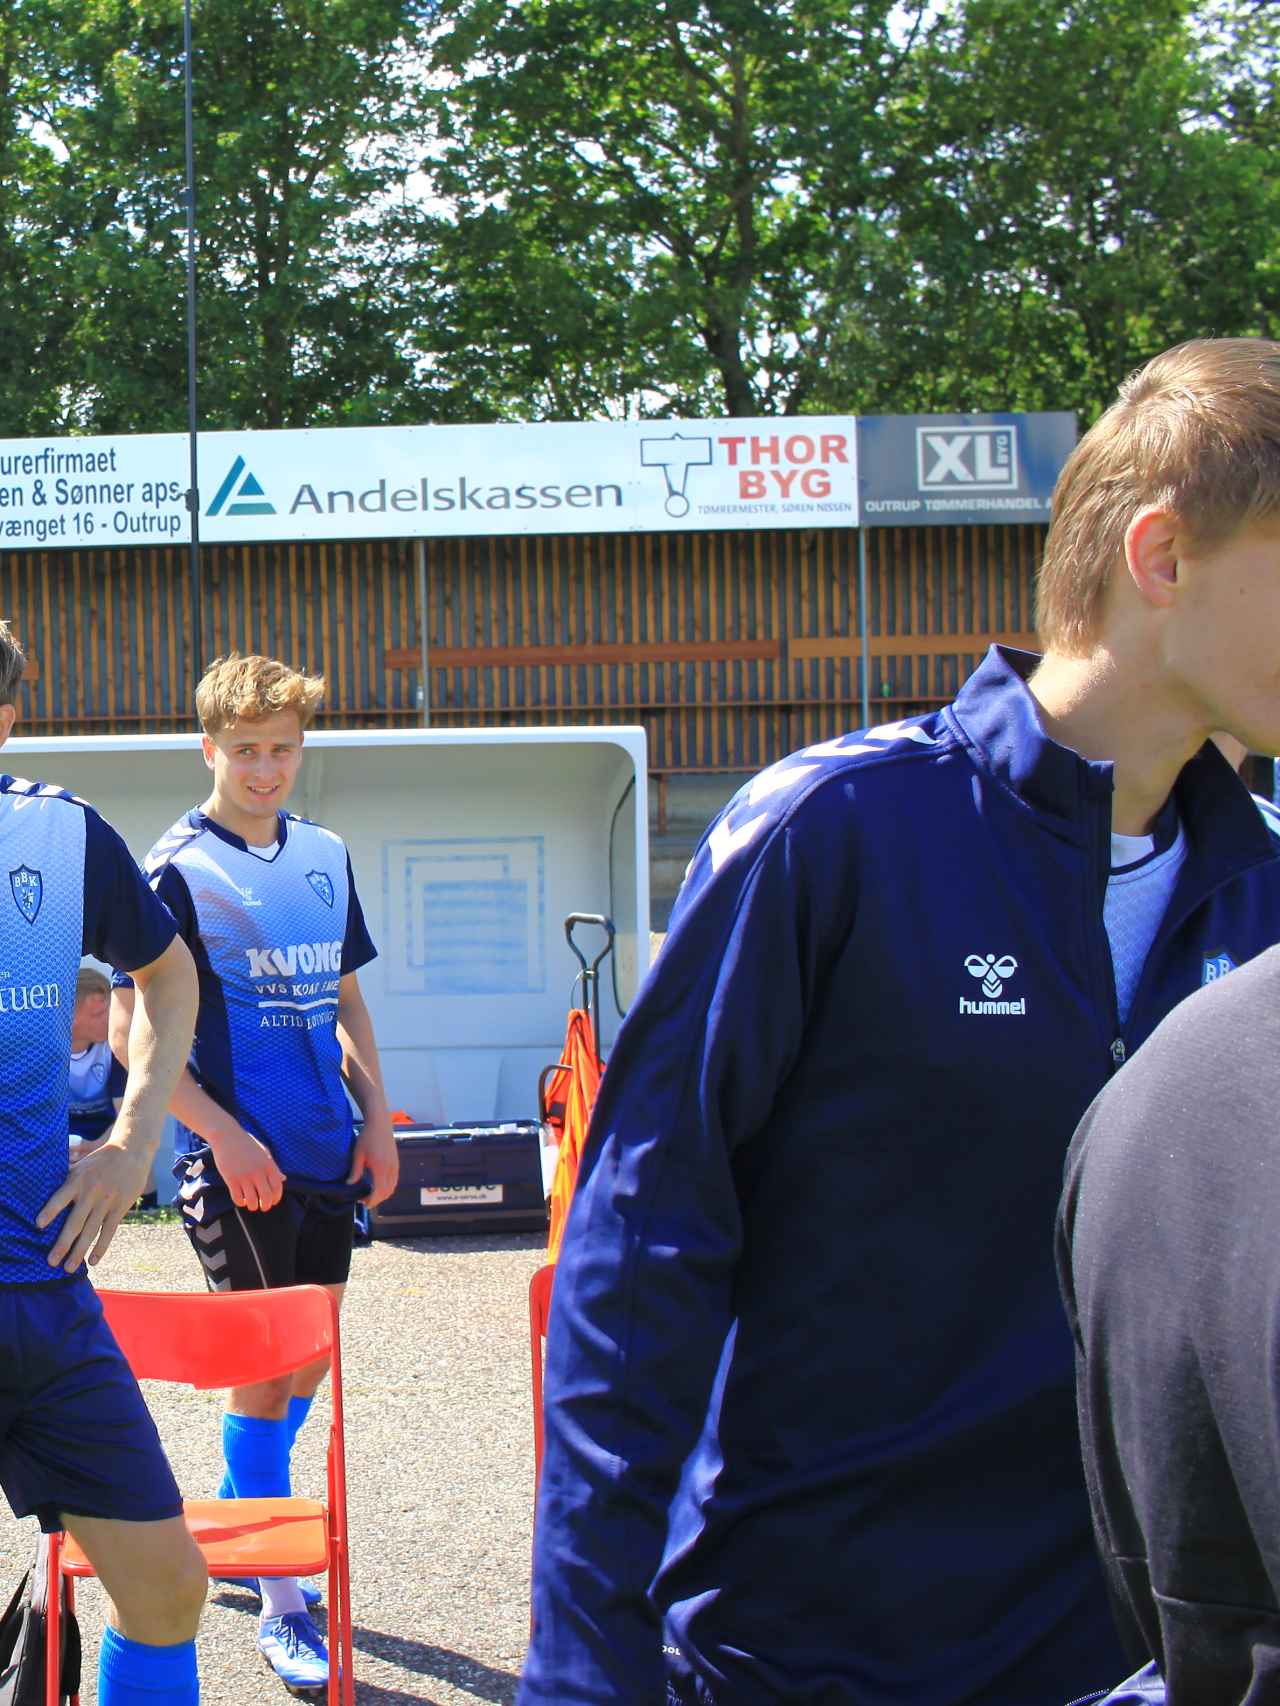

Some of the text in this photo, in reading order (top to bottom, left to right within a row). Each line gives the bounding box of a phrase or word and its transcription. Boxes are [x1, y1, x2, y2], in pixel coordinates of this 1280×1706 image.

[718, 434, 849, 466] THOR
[925, 434, 1010, 483] XL
[996, 435, 1009, 464] BYG
[31, 481, 48, 505] &
[55, 479, 138, 505] Sønner
[142, 482, 180, 508] aps
[289, 476, 623, 515] Andelskassen
[739, 468, 832, 500] BYG
[816, 503, 852, 513] NISSEN
[865, 499, 921, 512] OUTRUP
[72, 512, 95, 534] 16
[114, 511, 181, 537] Outrup
[246, 941, 343, 977] KVONG
[255, 983, 288, 994] VVS
[959, 996, 1026, 1015] hummel
[260, 1014, 304, 1028] ALTID
